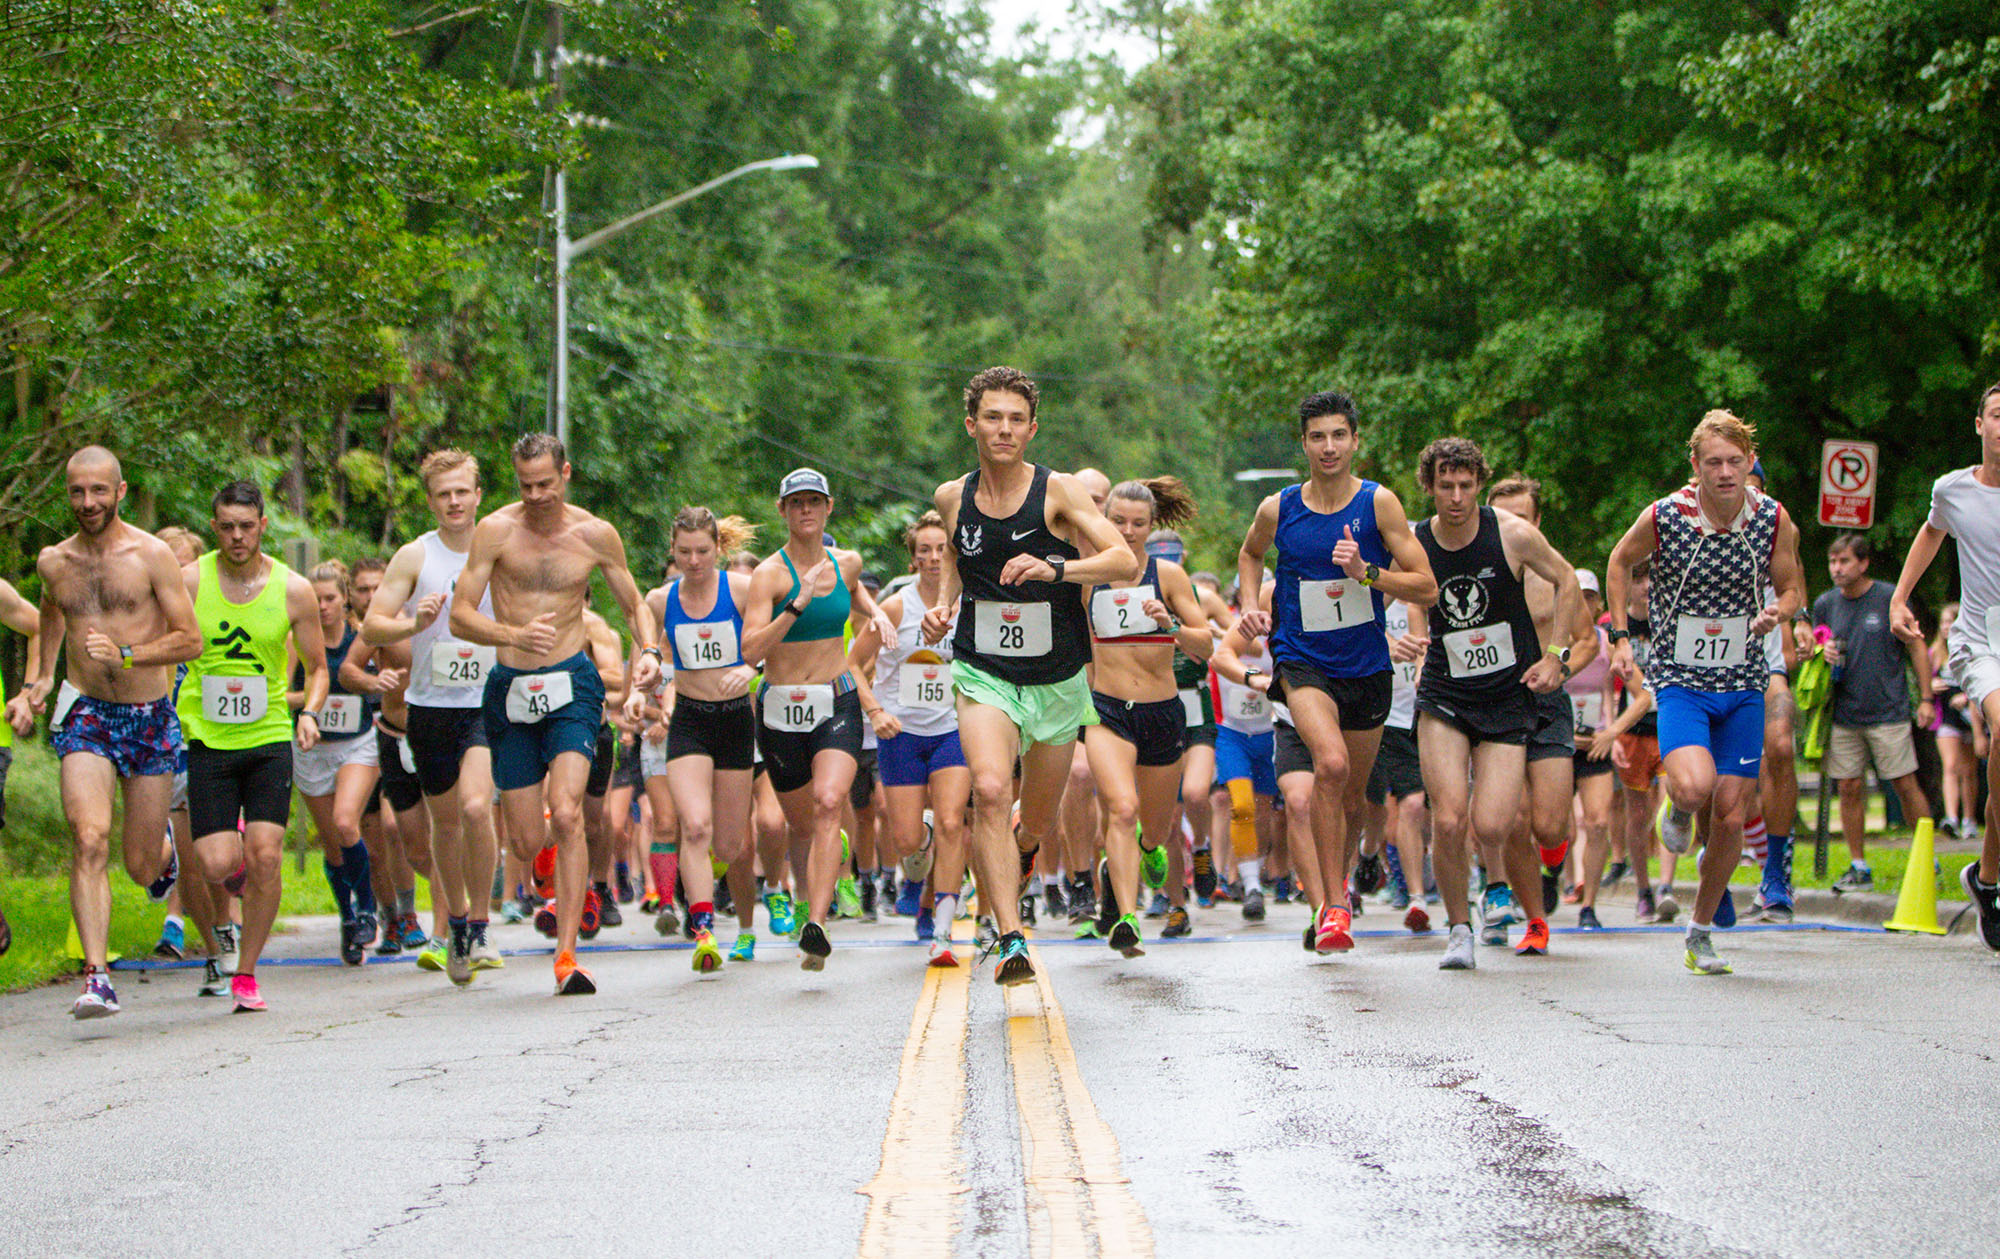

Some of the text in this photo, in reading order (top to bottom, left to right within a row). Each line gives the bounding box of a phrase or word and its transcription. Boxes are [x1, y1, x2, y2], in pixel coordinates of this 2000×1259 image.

[1118, 608, 1129, 629] 2
[1333, 600, 1343, 622] 1
[1447, 616, 1468, 628] TEAM
[999, 624, 1024, 649] 28
[692, 641, 722, 662] 146
[1464, 645, 1499, 670] 280
[1694, 638, 1731, 660] 217
[449, 661, 480, 681] 243
[917, 682, 944, 702] 155
[218, 696, 251, 717] 218
[528, 694, 550, 716] 43
[784, 704, 815, 725] 104
[324, 711, 347, 727] 191
